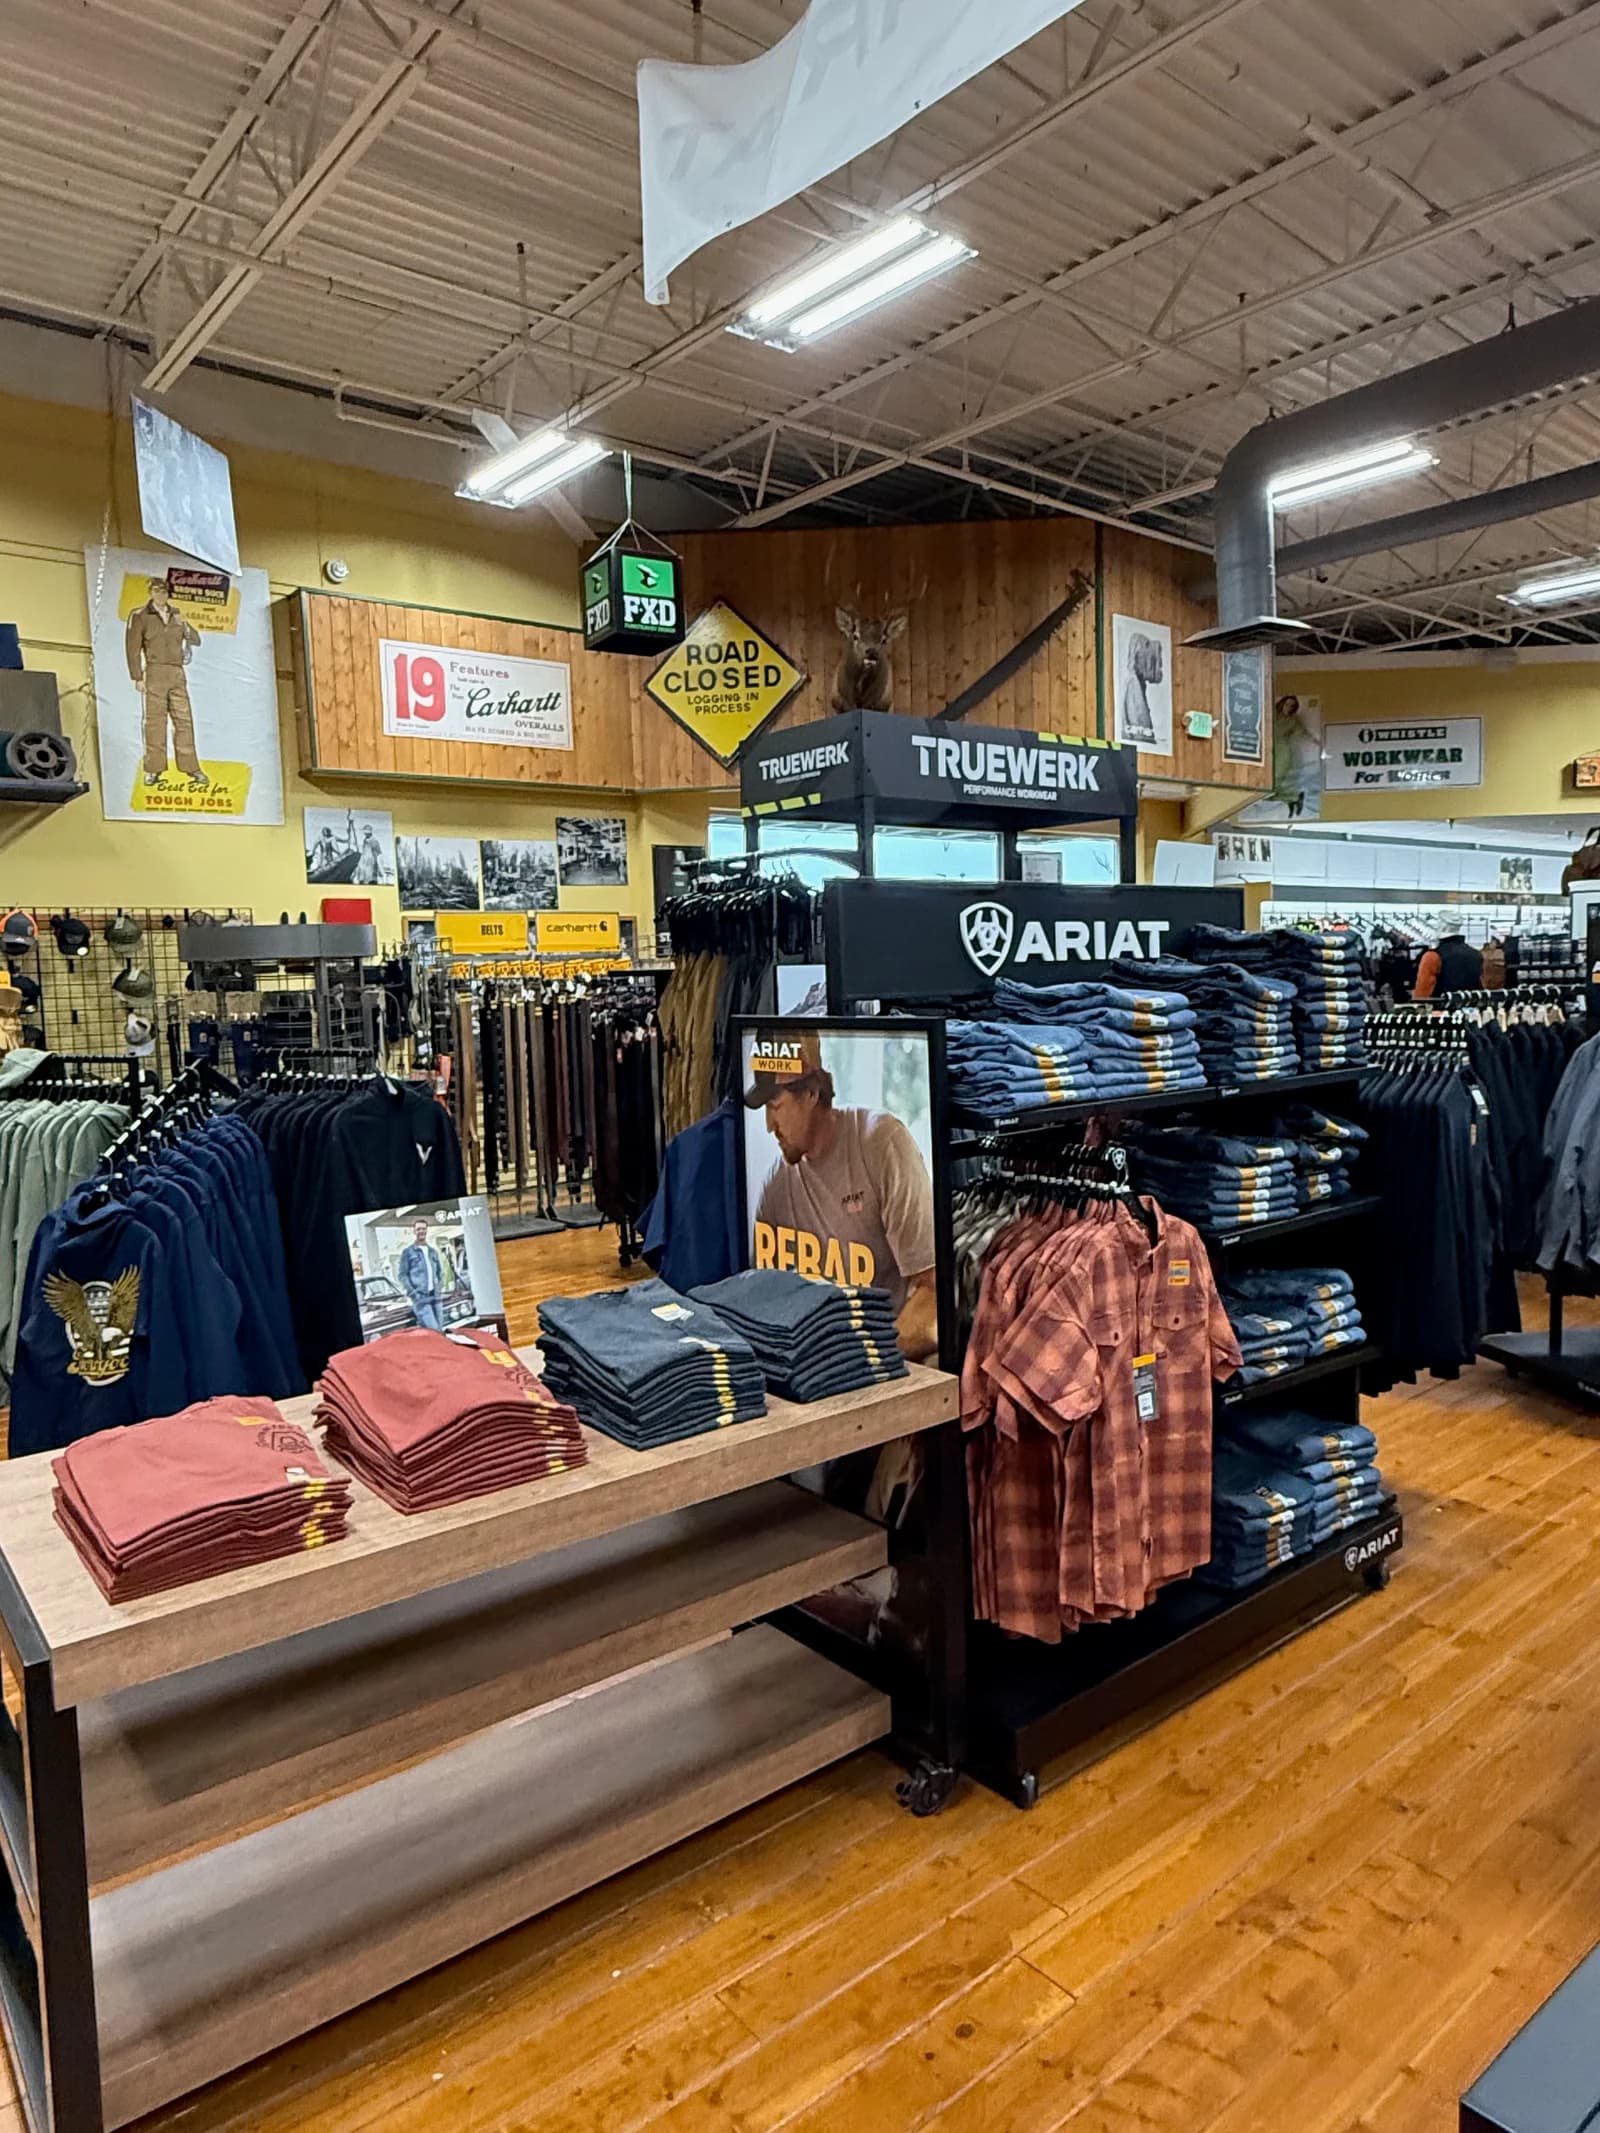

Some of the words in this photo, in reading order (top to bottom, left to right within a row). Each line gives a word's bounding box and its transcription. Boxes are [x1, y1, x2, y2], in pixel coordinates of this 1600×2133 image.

[586, 598, 611, 636] FXD
[686, 640, 760, 666] ROAD
[450, 661, 510, 680] Features
[664, 665, 782, 694] CLOSED
[394, 652, 447, 722] 19
[465, 687, 562, 719] Carhartt
[687, 693, 741, 705] LOGGING
[746, 692, 760, 701] IN
[695, 703, 752, 715] PROCESS
[514, 719, 566, 733] OVERALLS
[1378, 727, 1445, 740] WHISTLE
[758, 741, 850, 781] TRUEWERK
[911, 735, 1101, 792] TRUEWERK
[1343, 747, 1463, 768] WORKWEAR
[1354, 771, 1384, 784] For
[157, 778, 186, 793] Best
[188, 781, 209, 793] Bet
[211, 783, 230, 797] for
[963, 784, 1017, 798] PERFORMANCE
[1016, 788, 1058, 801] WORKWEAR
[145, 795, 193, 807] TOUGH
[199, 798, 233, 808] JOBS
[480, 923, 504, 937] BELTS
[546, 922, 598, 933] carhartt
[1013, 920, 1170, 963] ARIAT
[750, 1042, 802, 1058] ARIAT
[759, 1060, 792, 1071] WORK
[754, 1221, 876, 1290] REBAR
[1357, 1527, 1400, 1564] ARIAT
